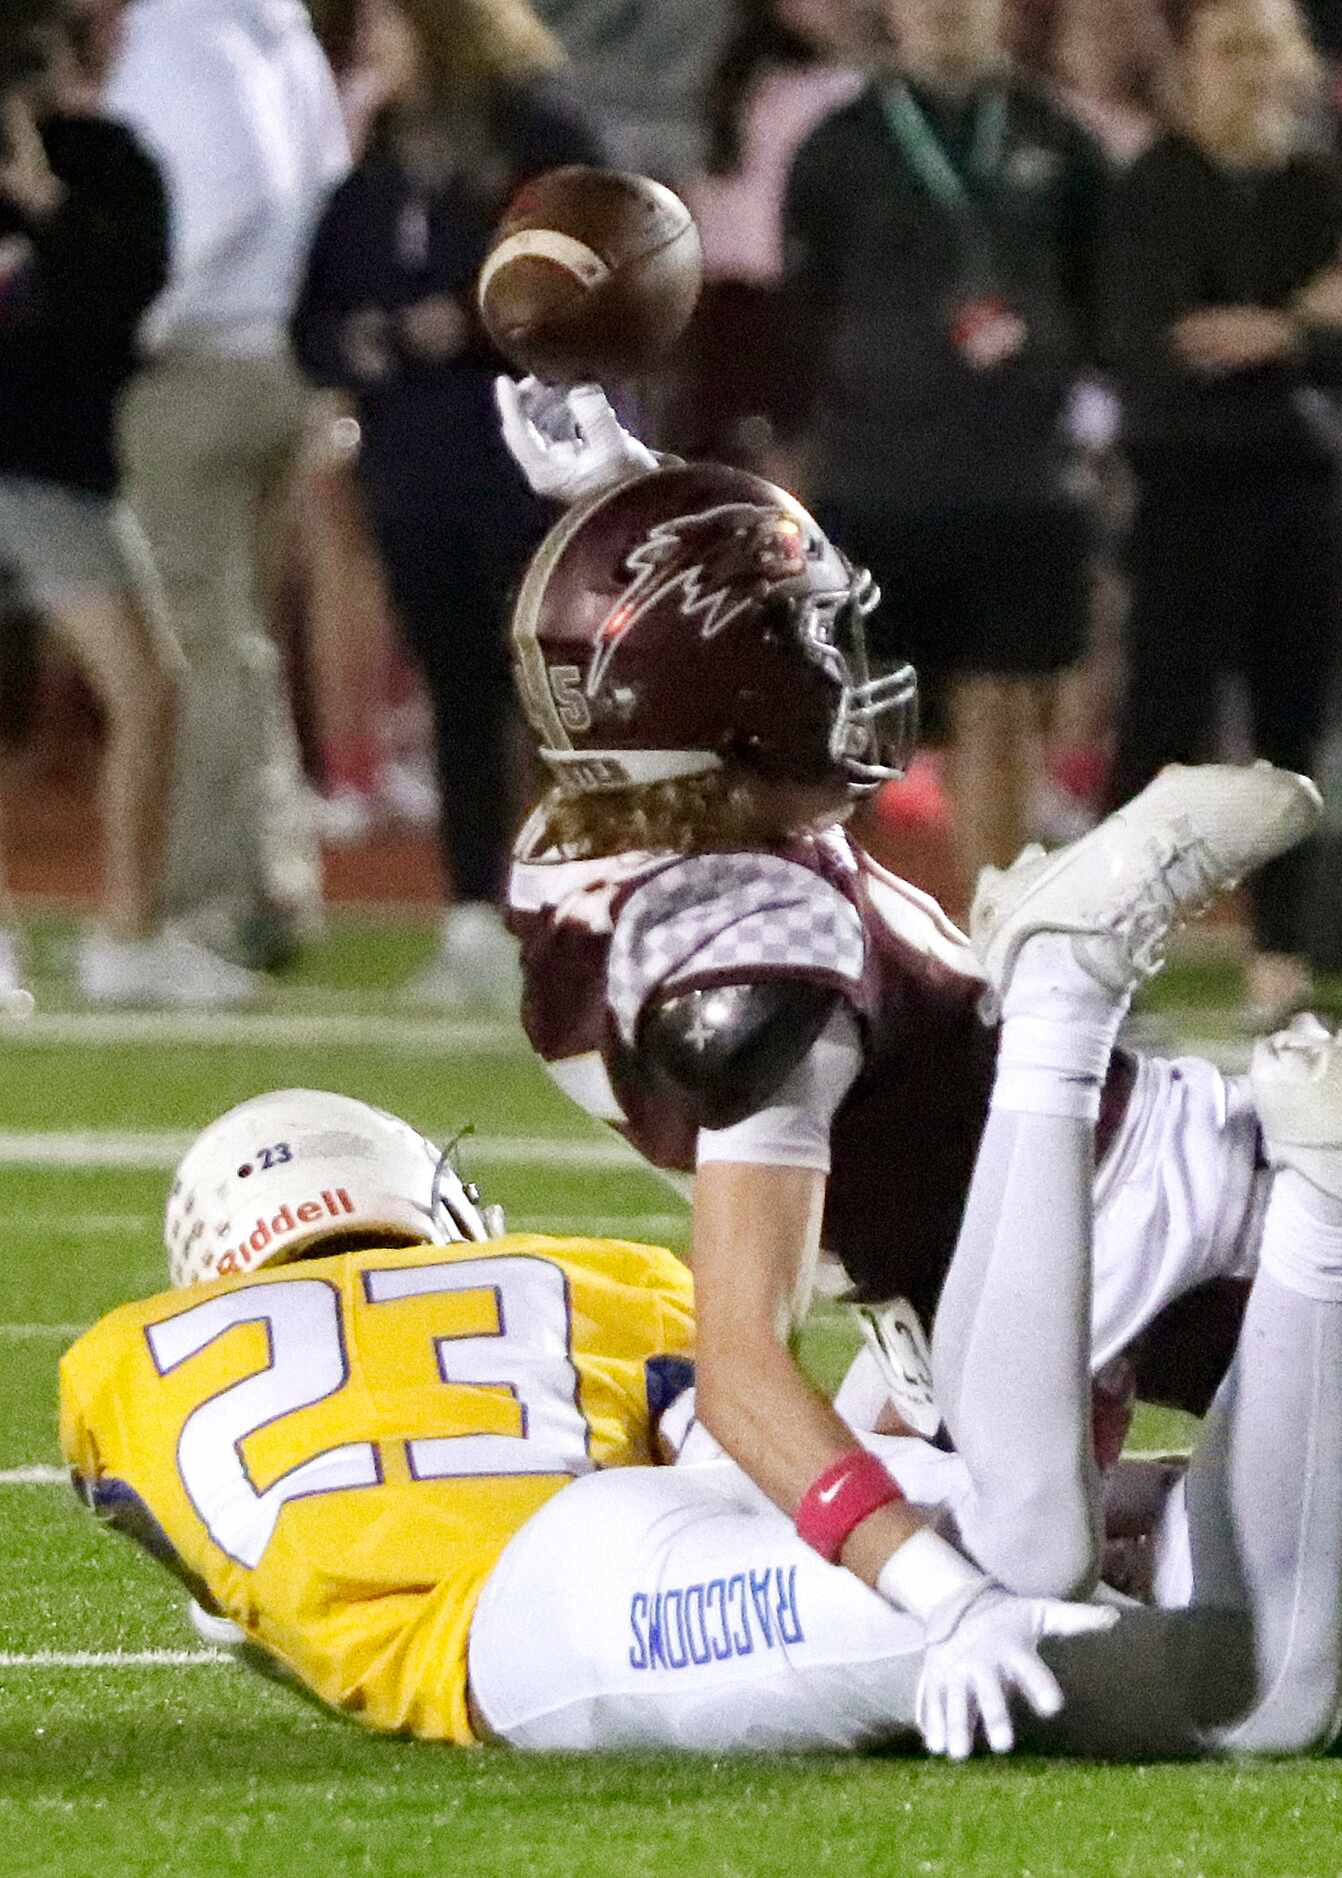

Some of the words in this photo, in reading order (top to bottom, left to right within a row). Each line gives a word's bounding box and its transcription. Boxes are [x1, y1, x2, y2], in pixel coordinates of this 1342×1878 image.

[256, 1141, 292, 1171] 23
[215, 1187, 356, 1277] Riddell
[143, 1252, 592, 1571] 23
[629, 1565, 805, 1671] RACCOONS
